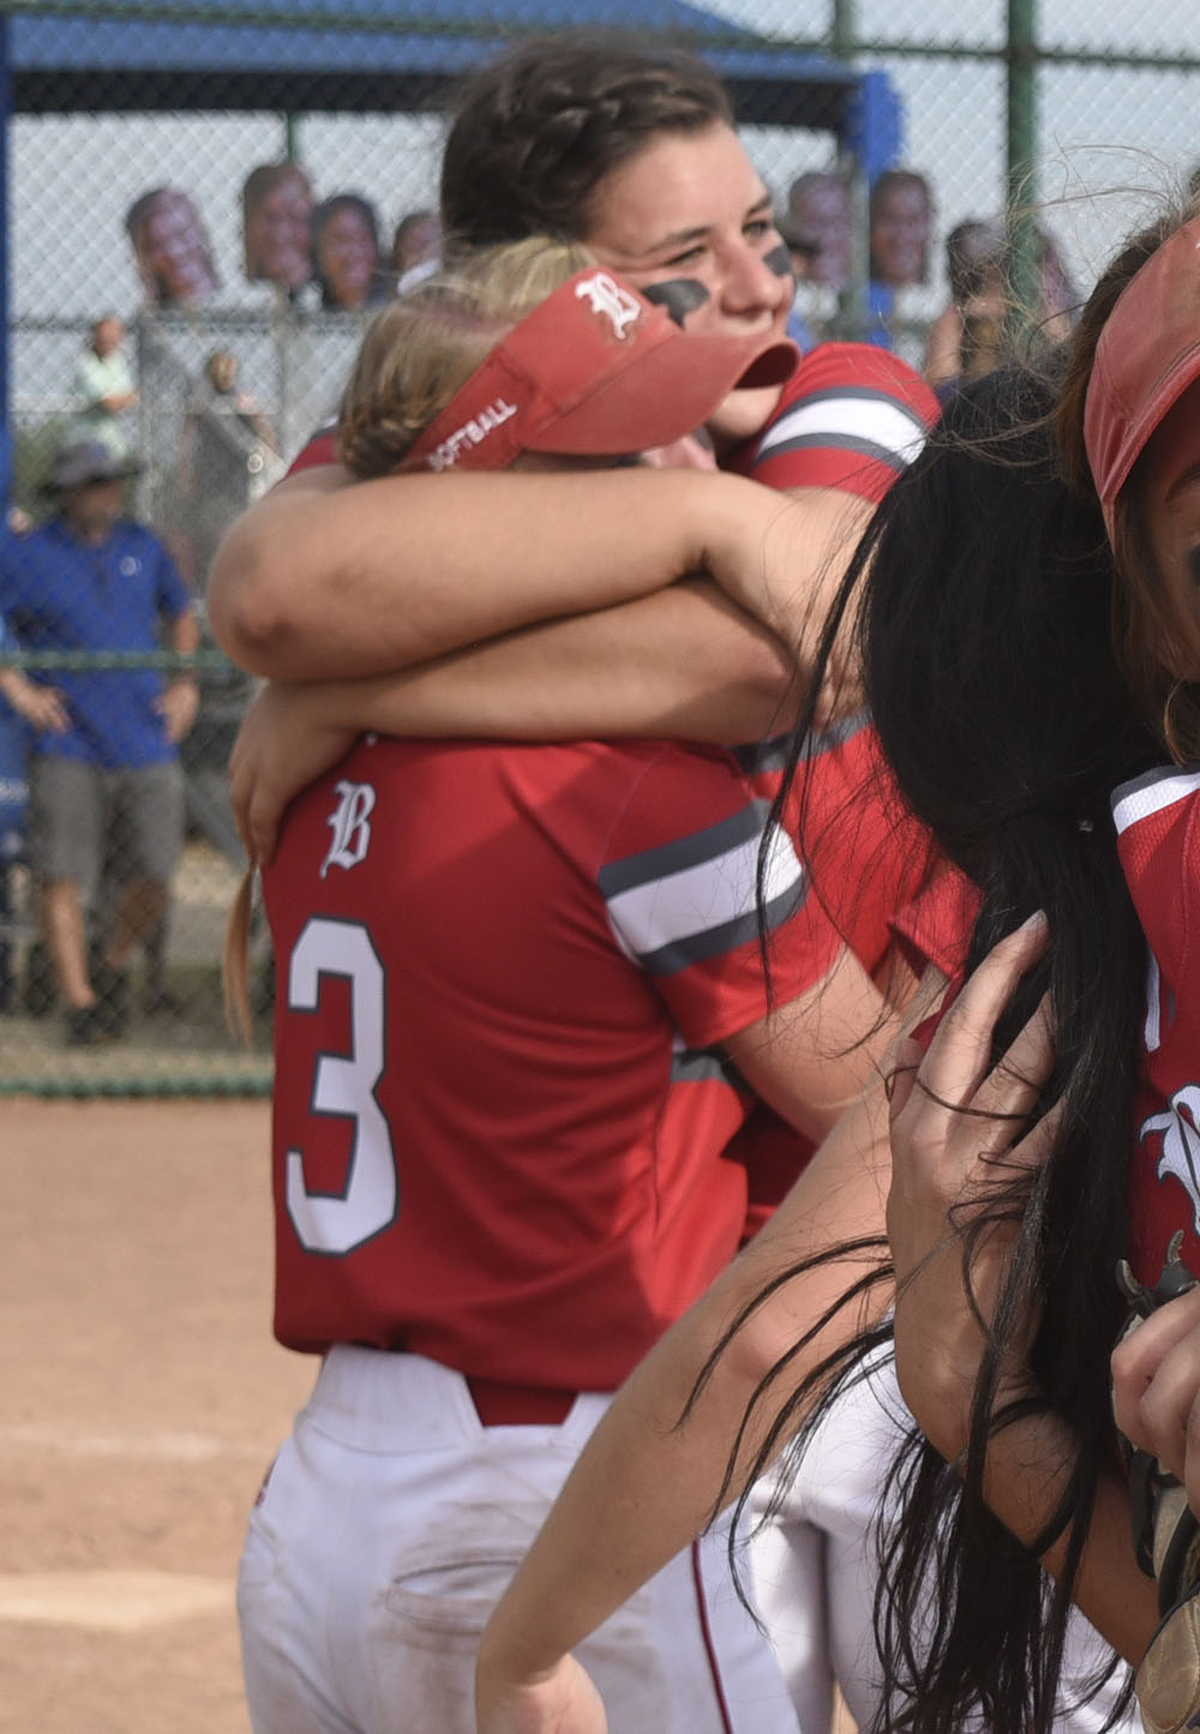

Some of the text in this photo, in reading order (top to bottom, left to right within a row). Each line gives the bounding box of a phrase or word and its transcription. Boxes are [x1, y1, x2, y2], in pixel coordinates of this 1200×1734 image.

[575, 272, 641, 340] B
[319, 780, 376, 881] B
[286, 912, 399, 1258] 3
